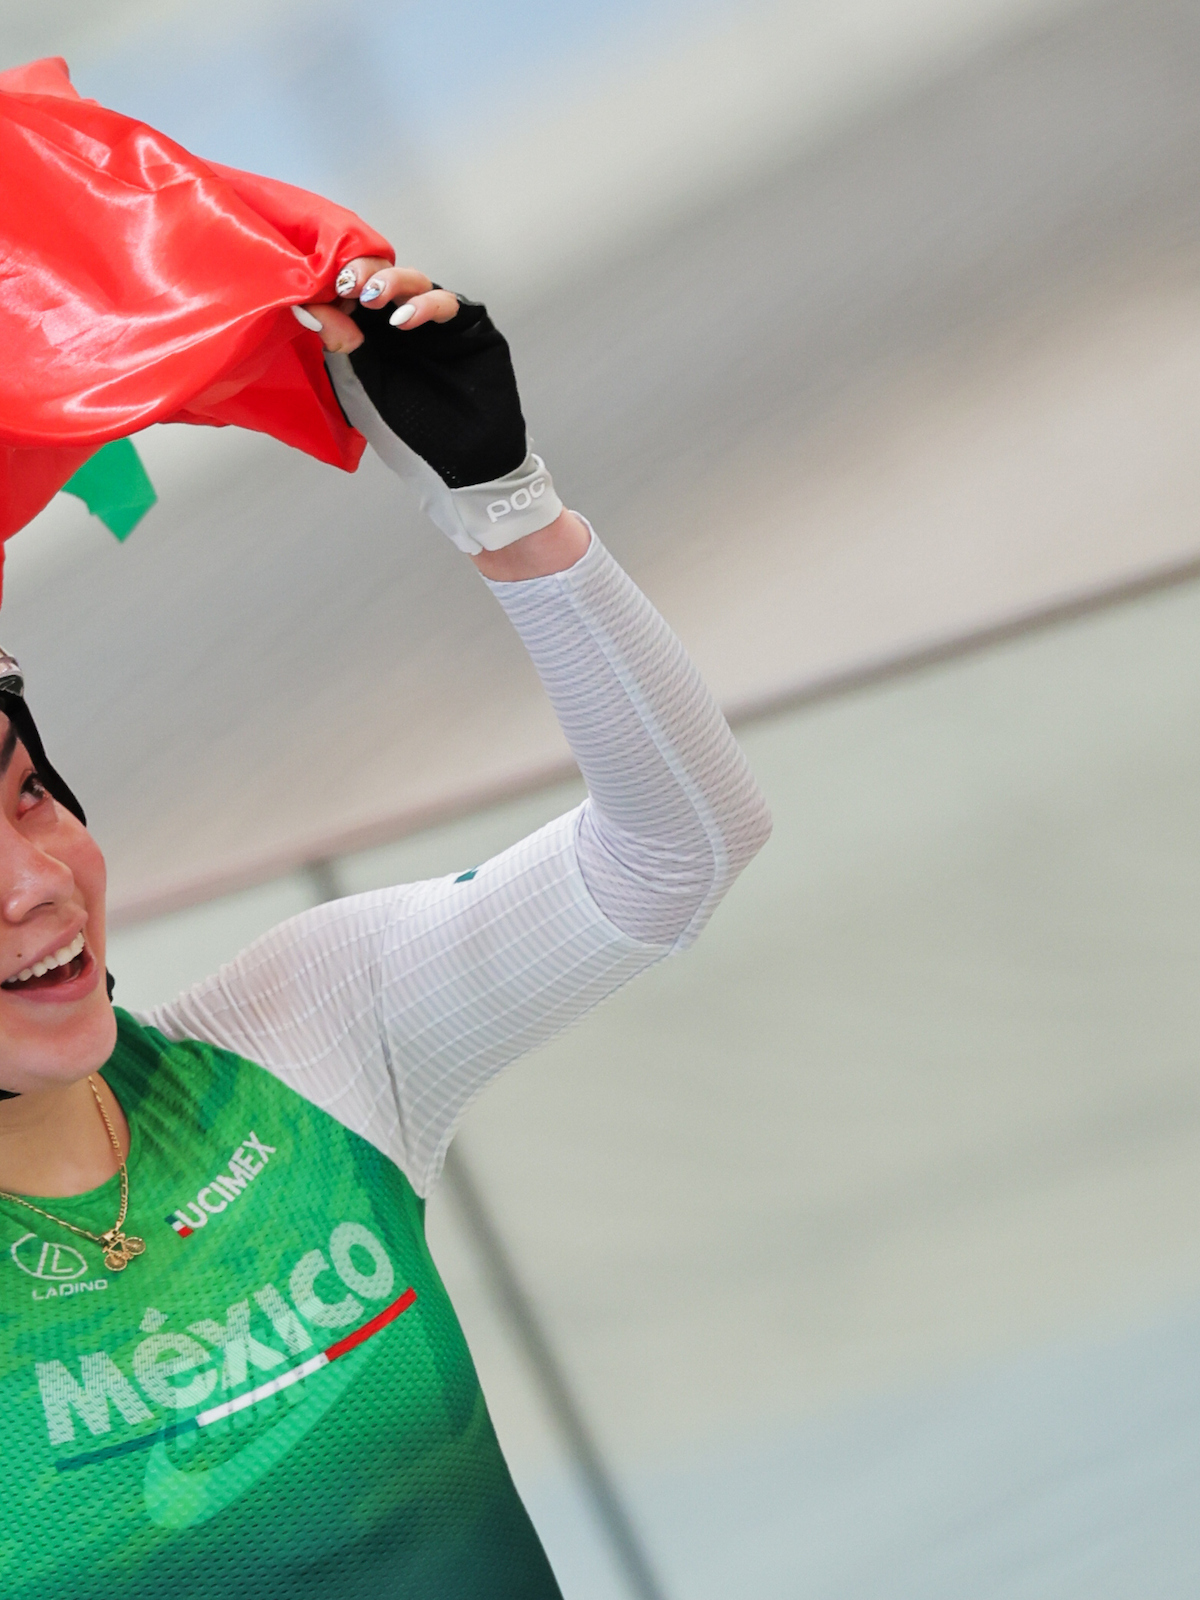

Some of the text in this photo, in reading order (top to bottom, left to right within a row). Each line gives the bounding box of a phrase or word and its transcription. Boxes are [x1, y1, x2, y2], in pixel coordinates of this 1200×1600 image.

[486, 477, 546, 523] POC
[174, 1131, 277, 1229] UCIMEX
[32, 1278, 109, 1301] LADINO
